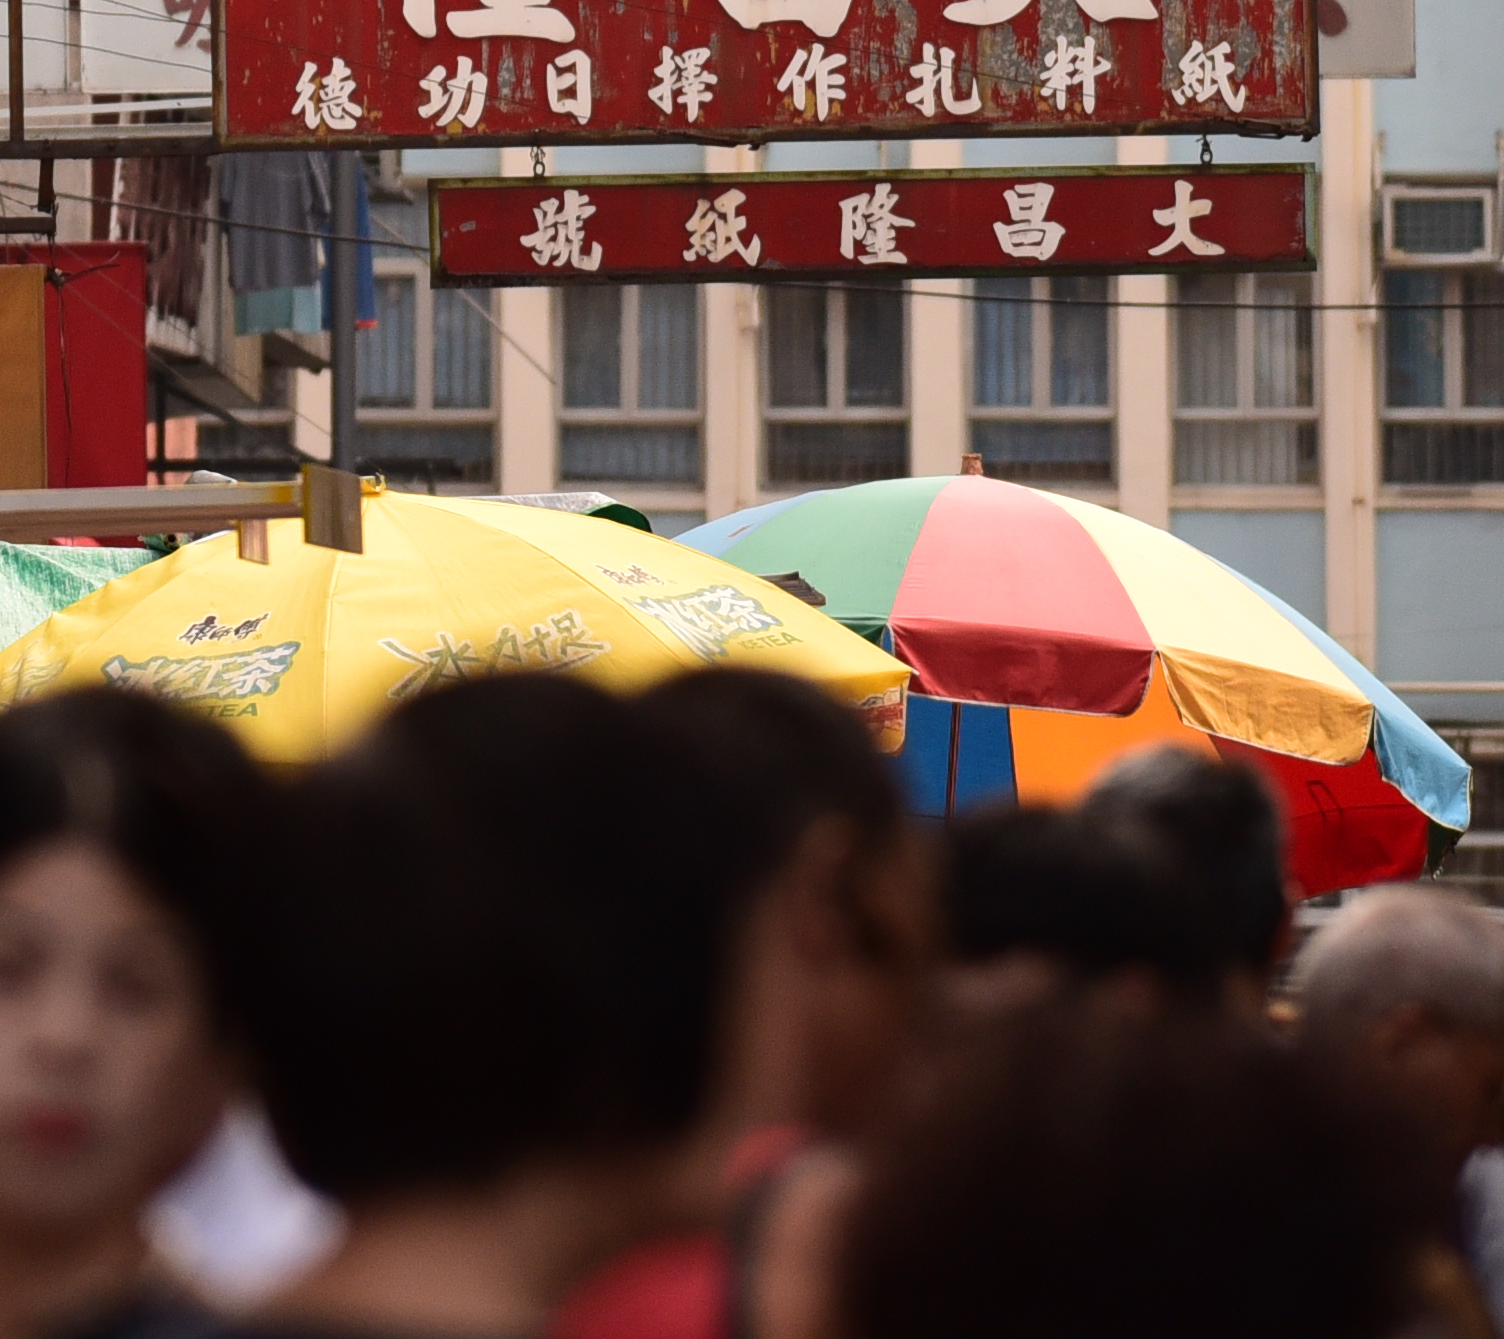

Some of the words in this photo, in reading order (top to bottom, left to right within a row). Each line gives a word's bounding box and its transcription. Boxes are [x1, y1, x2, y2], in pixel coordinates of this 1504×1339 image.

[519, 178, 1227, 273] 大昌隆紙號
